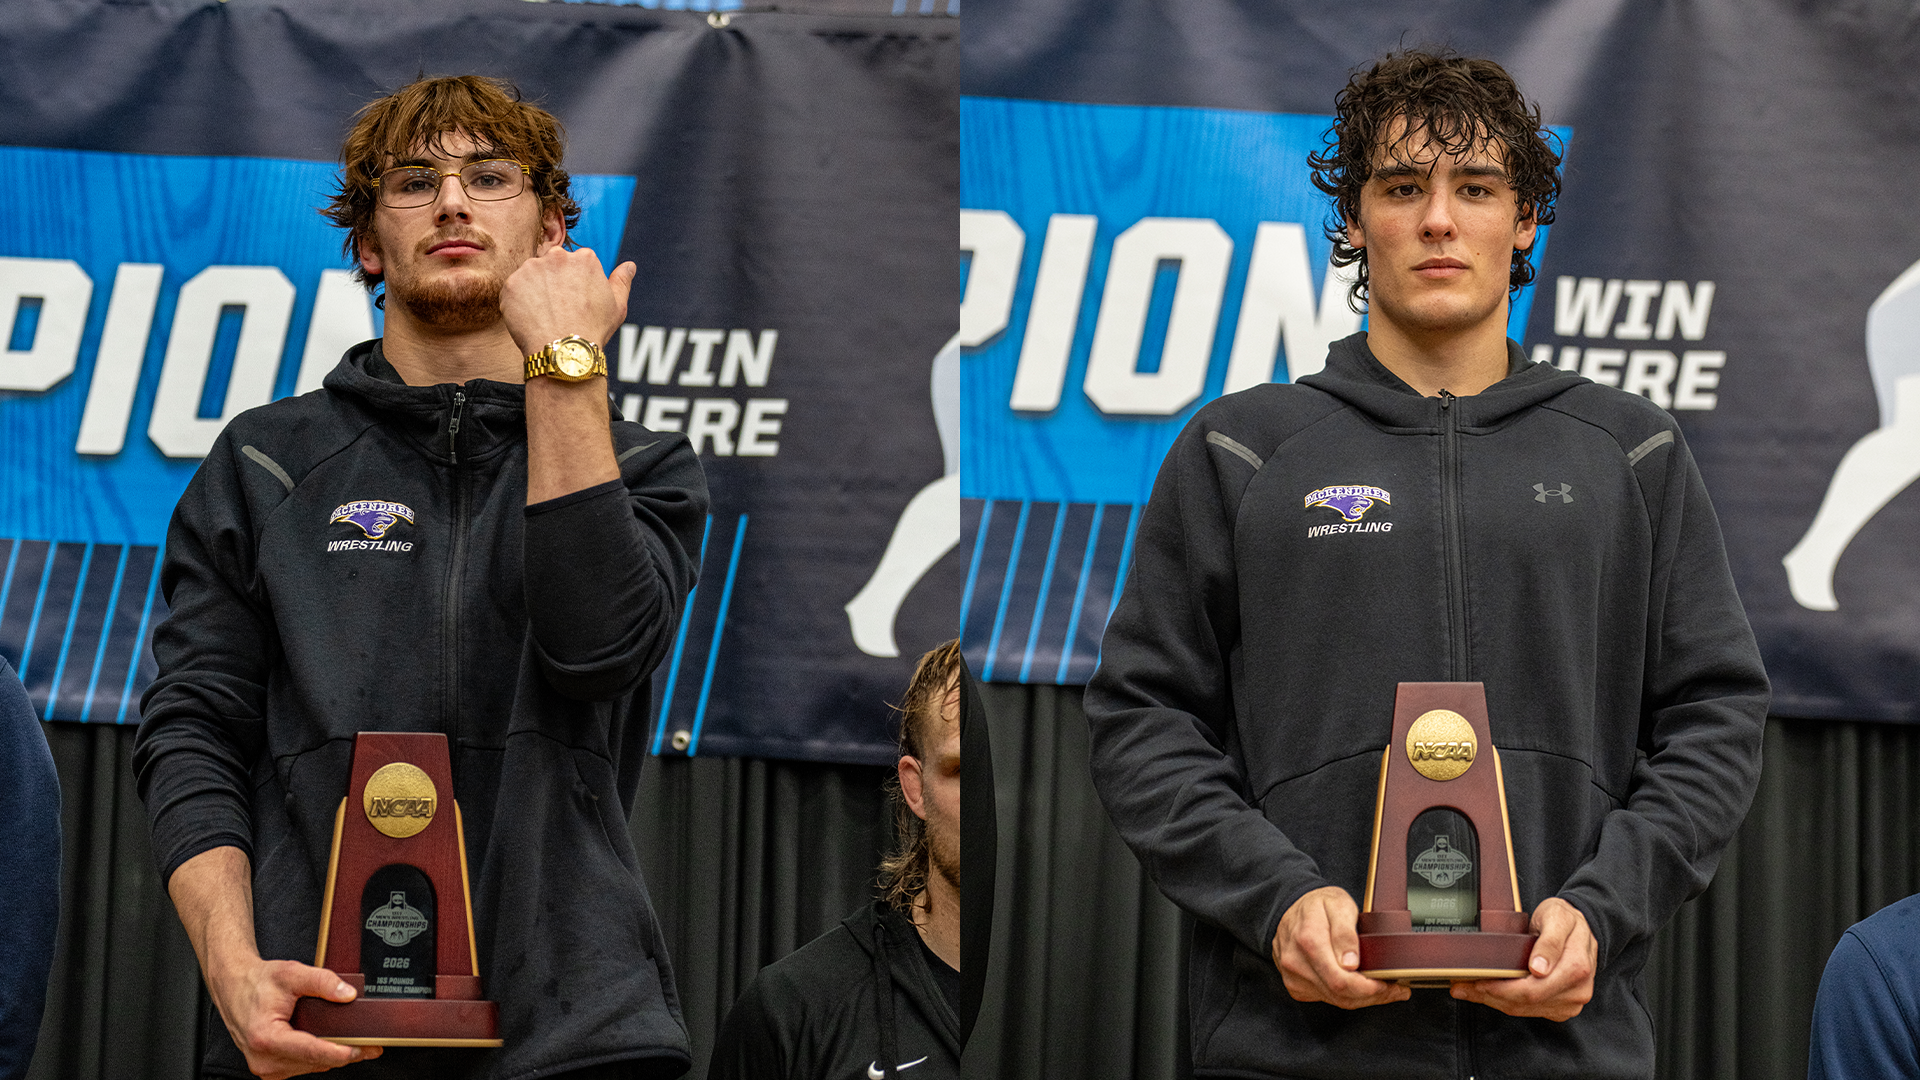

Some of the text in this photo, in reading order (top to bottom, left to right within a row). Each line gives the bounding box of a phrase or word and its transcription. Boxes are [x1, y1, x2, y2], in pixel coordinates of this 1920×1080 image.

[1554, 275, 1716, 341] WIN
[617, 323, 778, 387] WIN
[1308, 522, 1393, 538] WRESTLING
[327, 540, 414, 552] WRESTLING
[1413, 742, 1474, 761] NCAA
[370, 796, 433, 817] NCAA
[1431, 898, 1456, 909] 2026
[367, 920, 427, 929] CHAMPIONSHIPS
[383, 957, 410, 969] 2026
[389, 977, 414, 985] POUNDS
